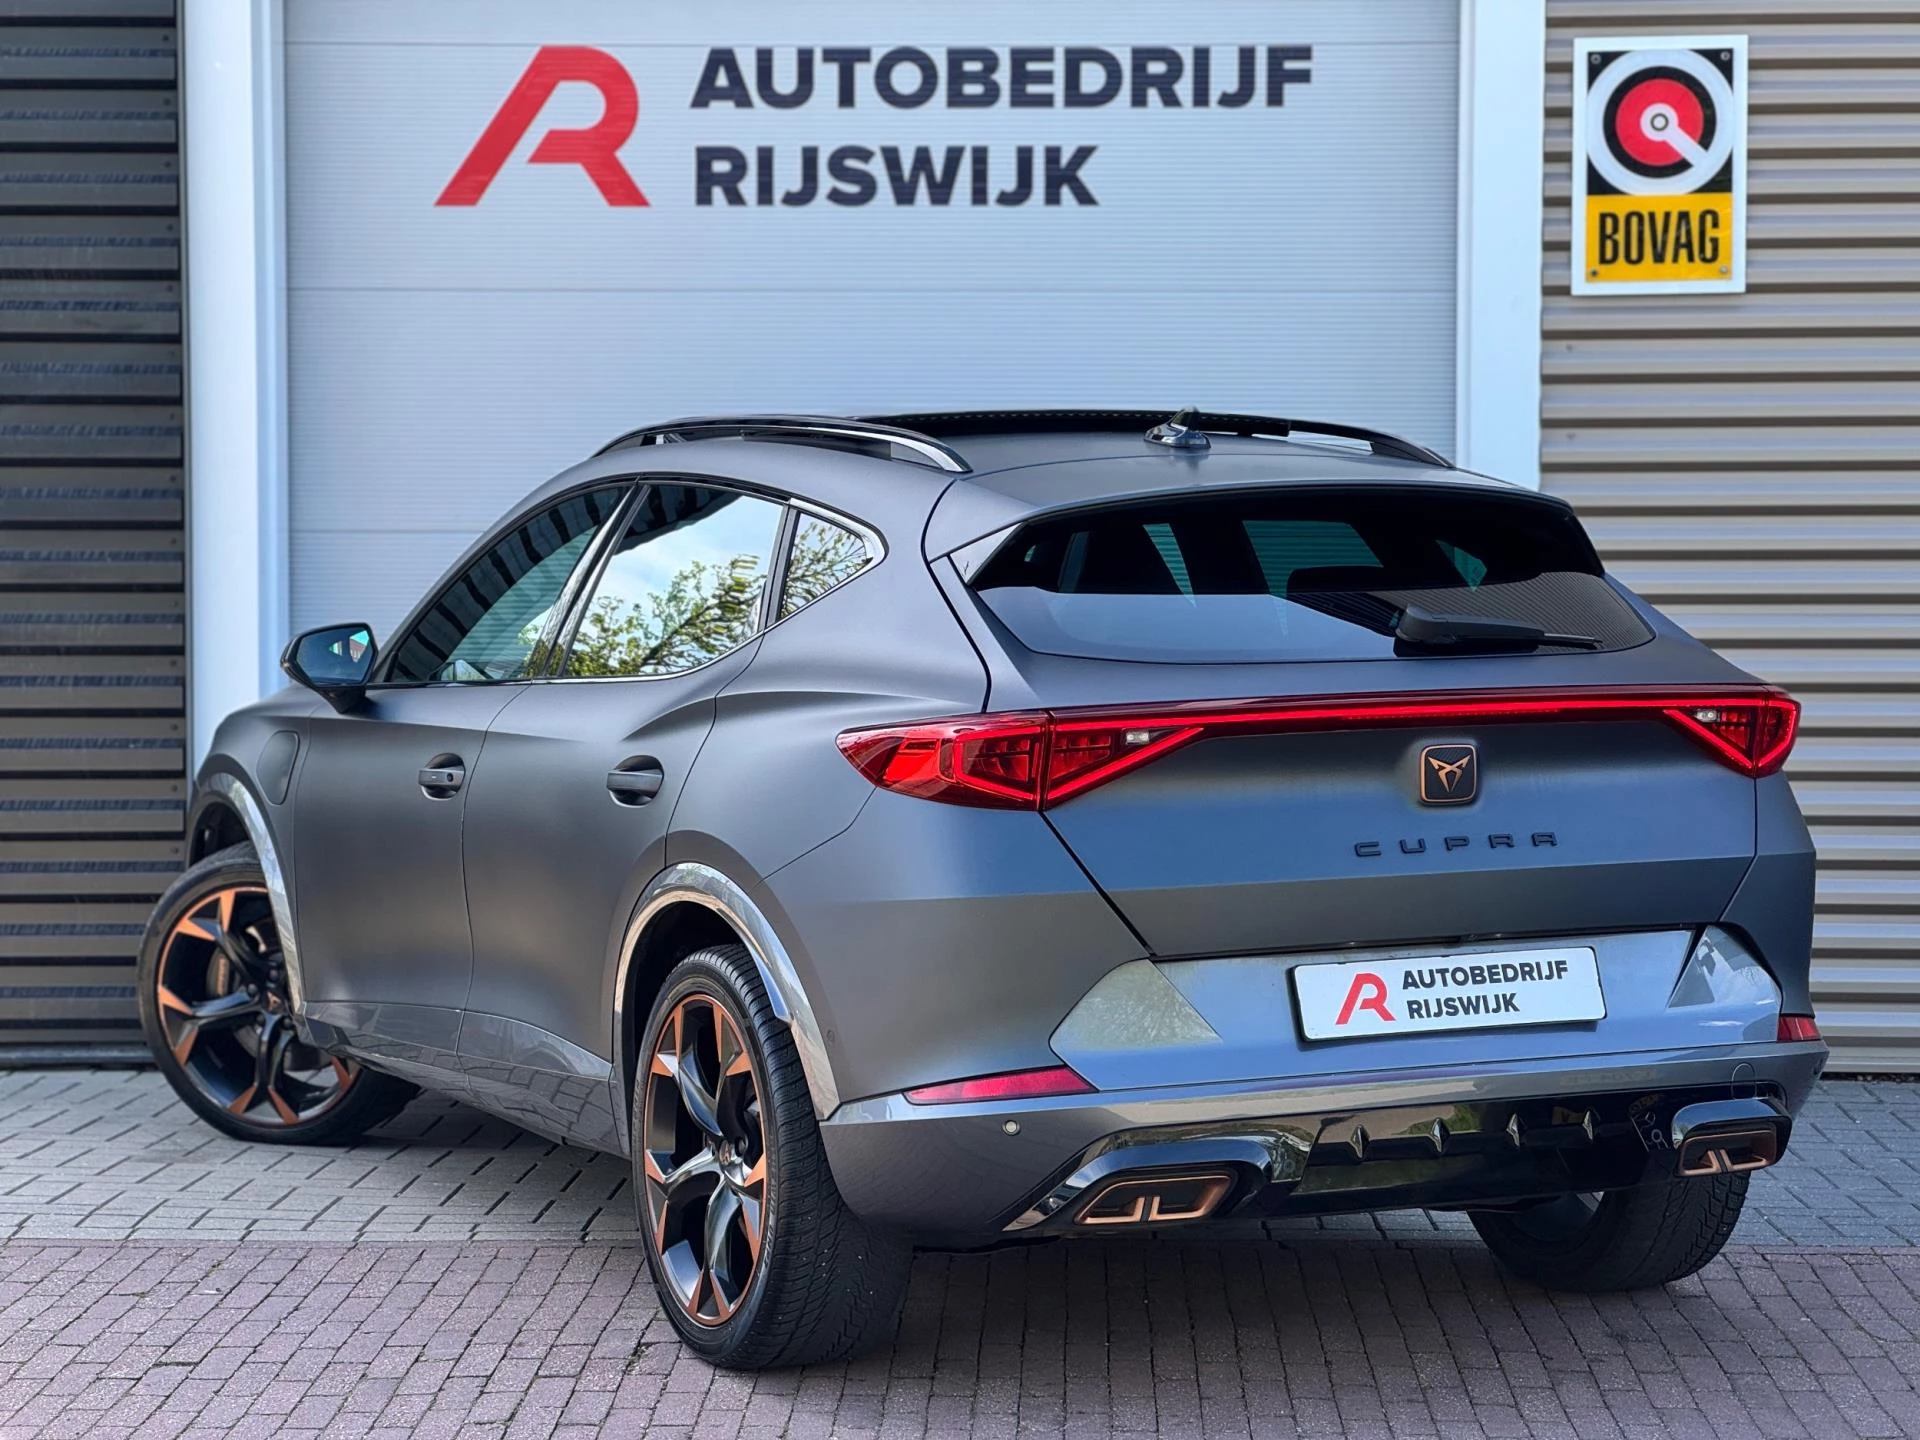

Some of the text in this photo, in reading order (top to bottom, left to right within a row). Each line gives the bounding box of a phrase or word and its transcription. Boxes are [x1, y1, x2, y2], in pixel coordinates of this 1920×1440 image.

[690, 45, 1313, 109] AUTOBEDRIJF
[694, 145, 1100, 207] RIJSWIJK
[1598, 209, 1720, 265] BOVAG
[1354, 831, 1559, 858] CUPRA
[1402, 960, 1568, 990] AUTOBEDRIJF
[1407, 993, 1520, 1020] RIJSWIJK
